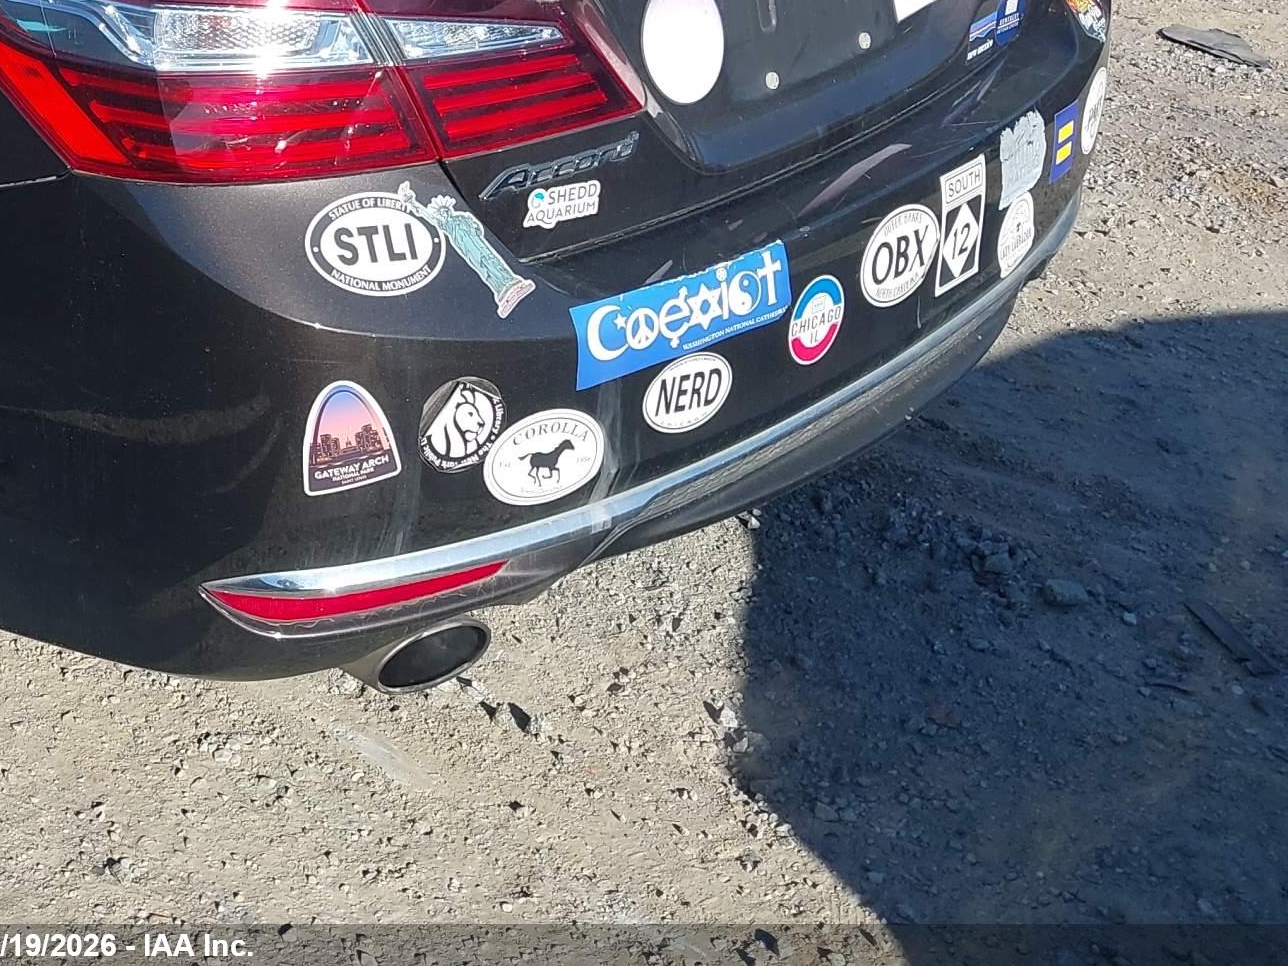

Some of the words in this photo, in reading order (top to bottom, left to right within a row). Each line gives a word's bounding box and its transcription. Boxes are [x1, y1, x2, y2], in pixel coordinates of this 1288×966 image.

[478, 130, 640, 202] Accord
[548, 183, 598, 206] SHEDD
[948, 168, 981, 198] SOUTH
[328, 201, 362, 220] STATUE
[362, 197, 376, 208] OF
[376, 197, 411, 214] LIBERTY
[527, 200, 596, 225] AQUARIUM
[333, 222, 419, 266] STLI
[871, 224, 930, 286] OBX
[951, 222, 971, 260] 12
[331, 268, 380, 292] NATIONAL
[381, 264, 432, 292] MONUMENT
[682, 330, 725, 351] WASHINGTON
[725, 319, 756, 335] NATIONAL
[791, 305, 842, 337] CHICAGO
[810, 329, 819, 345] IL
[654, 367, 723, 418] NERD
[492, 403, 505, 435] Library
[512, 421, 589, 446] COROLLA
[314, 462, 361, 480] GATEWAY
[361, 454, 390, 470] ARCH
